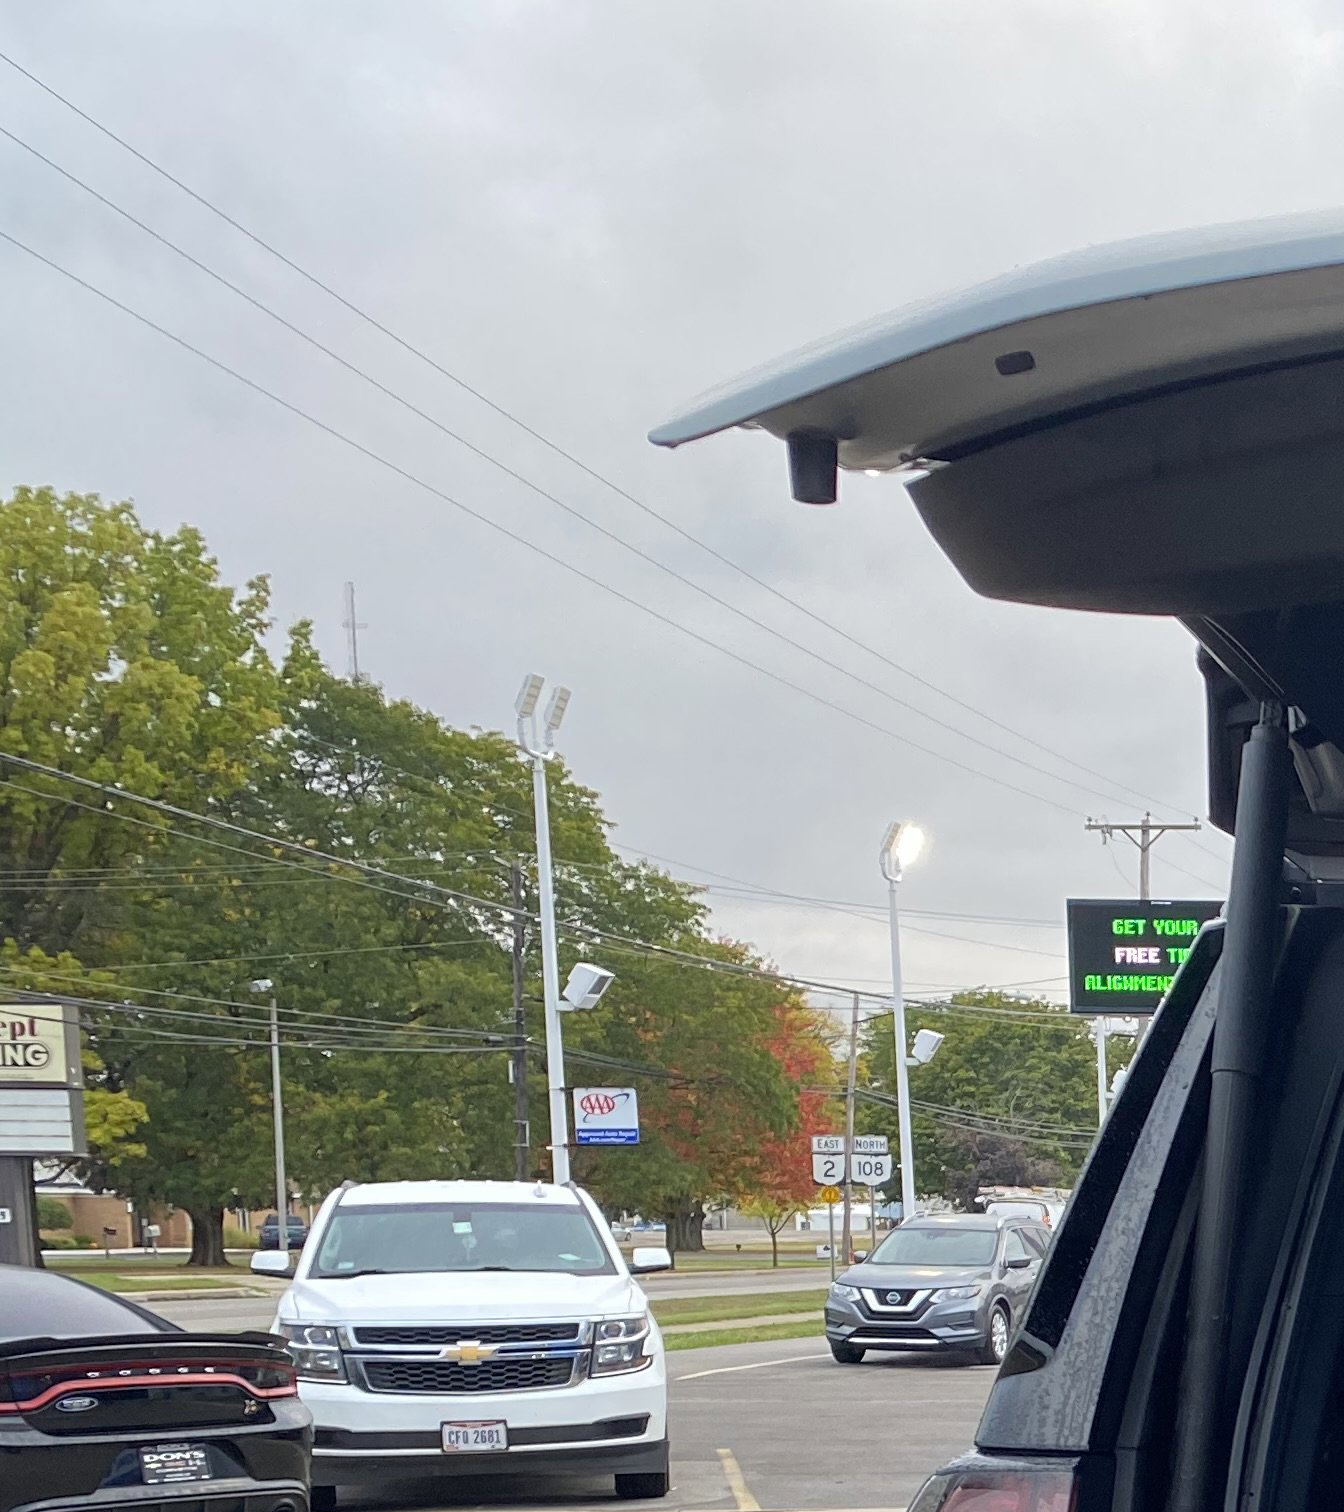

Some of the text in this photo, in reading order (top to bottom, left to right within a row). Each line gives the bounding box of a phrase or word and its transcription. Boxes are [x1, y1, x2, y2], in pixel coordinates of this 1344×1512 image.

[1112, 919, 1198, 935] GET YOUR
[1114, 947, 1161, 964] FREE
[817, 1138, 839, 1149] EAST
[855, 1138, 886, 1149] NORTH
[823, 1160, 836, 1178] 2
[858, 1160, 884, 1177] 108
[473, 1429, 501, 1444] 2681
